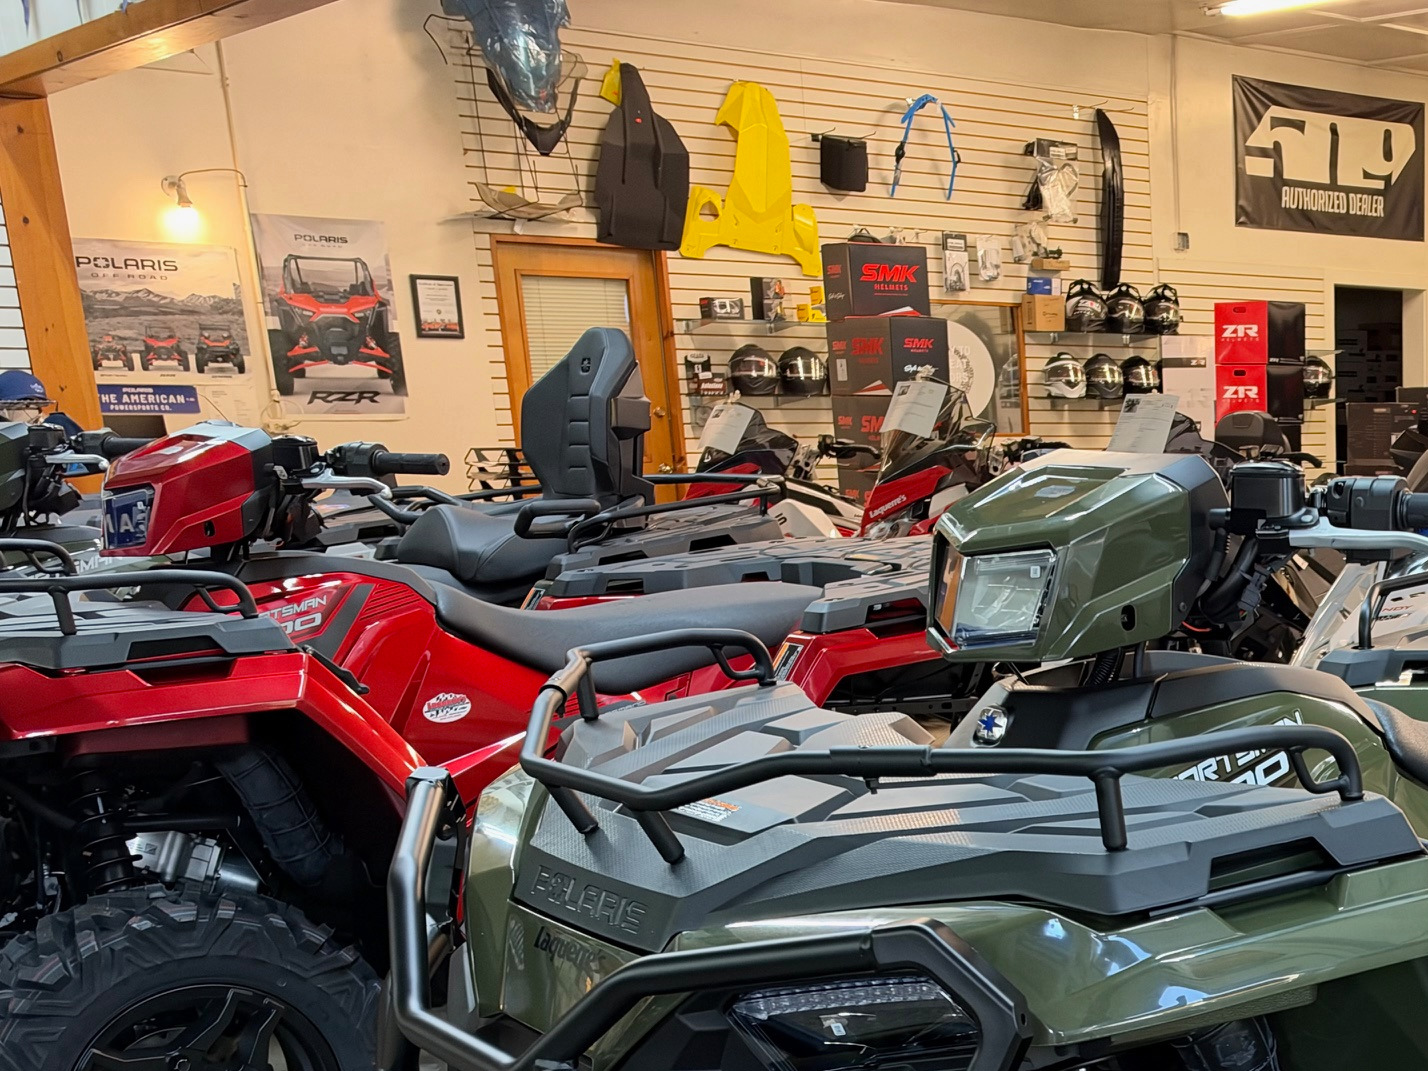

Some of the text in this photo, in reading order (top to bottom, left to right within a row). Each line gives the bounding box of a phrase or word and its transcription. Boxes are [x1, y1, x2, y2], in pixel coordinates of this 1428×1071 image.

[1281, 186, 1385, 217] AUTHORIZED DEALER
[294, 233, 348, 244] POLARIS
[75, 256, 178, 272] POLARIS
[860, 263, 920, 283] SMK
[874, 283, 909, 291] HELMETS
[851, 337, 885, 356] SMK
[903, 338, 935, 349] SMK
[122, 393, 186, 404] AMERICAN
[307, 390, 382, 405] RZR
[861, 415, 885, 433] SM
[868, 494, 907, 519] Laquerre's
[531, 864, 649, 935] POLARIS
